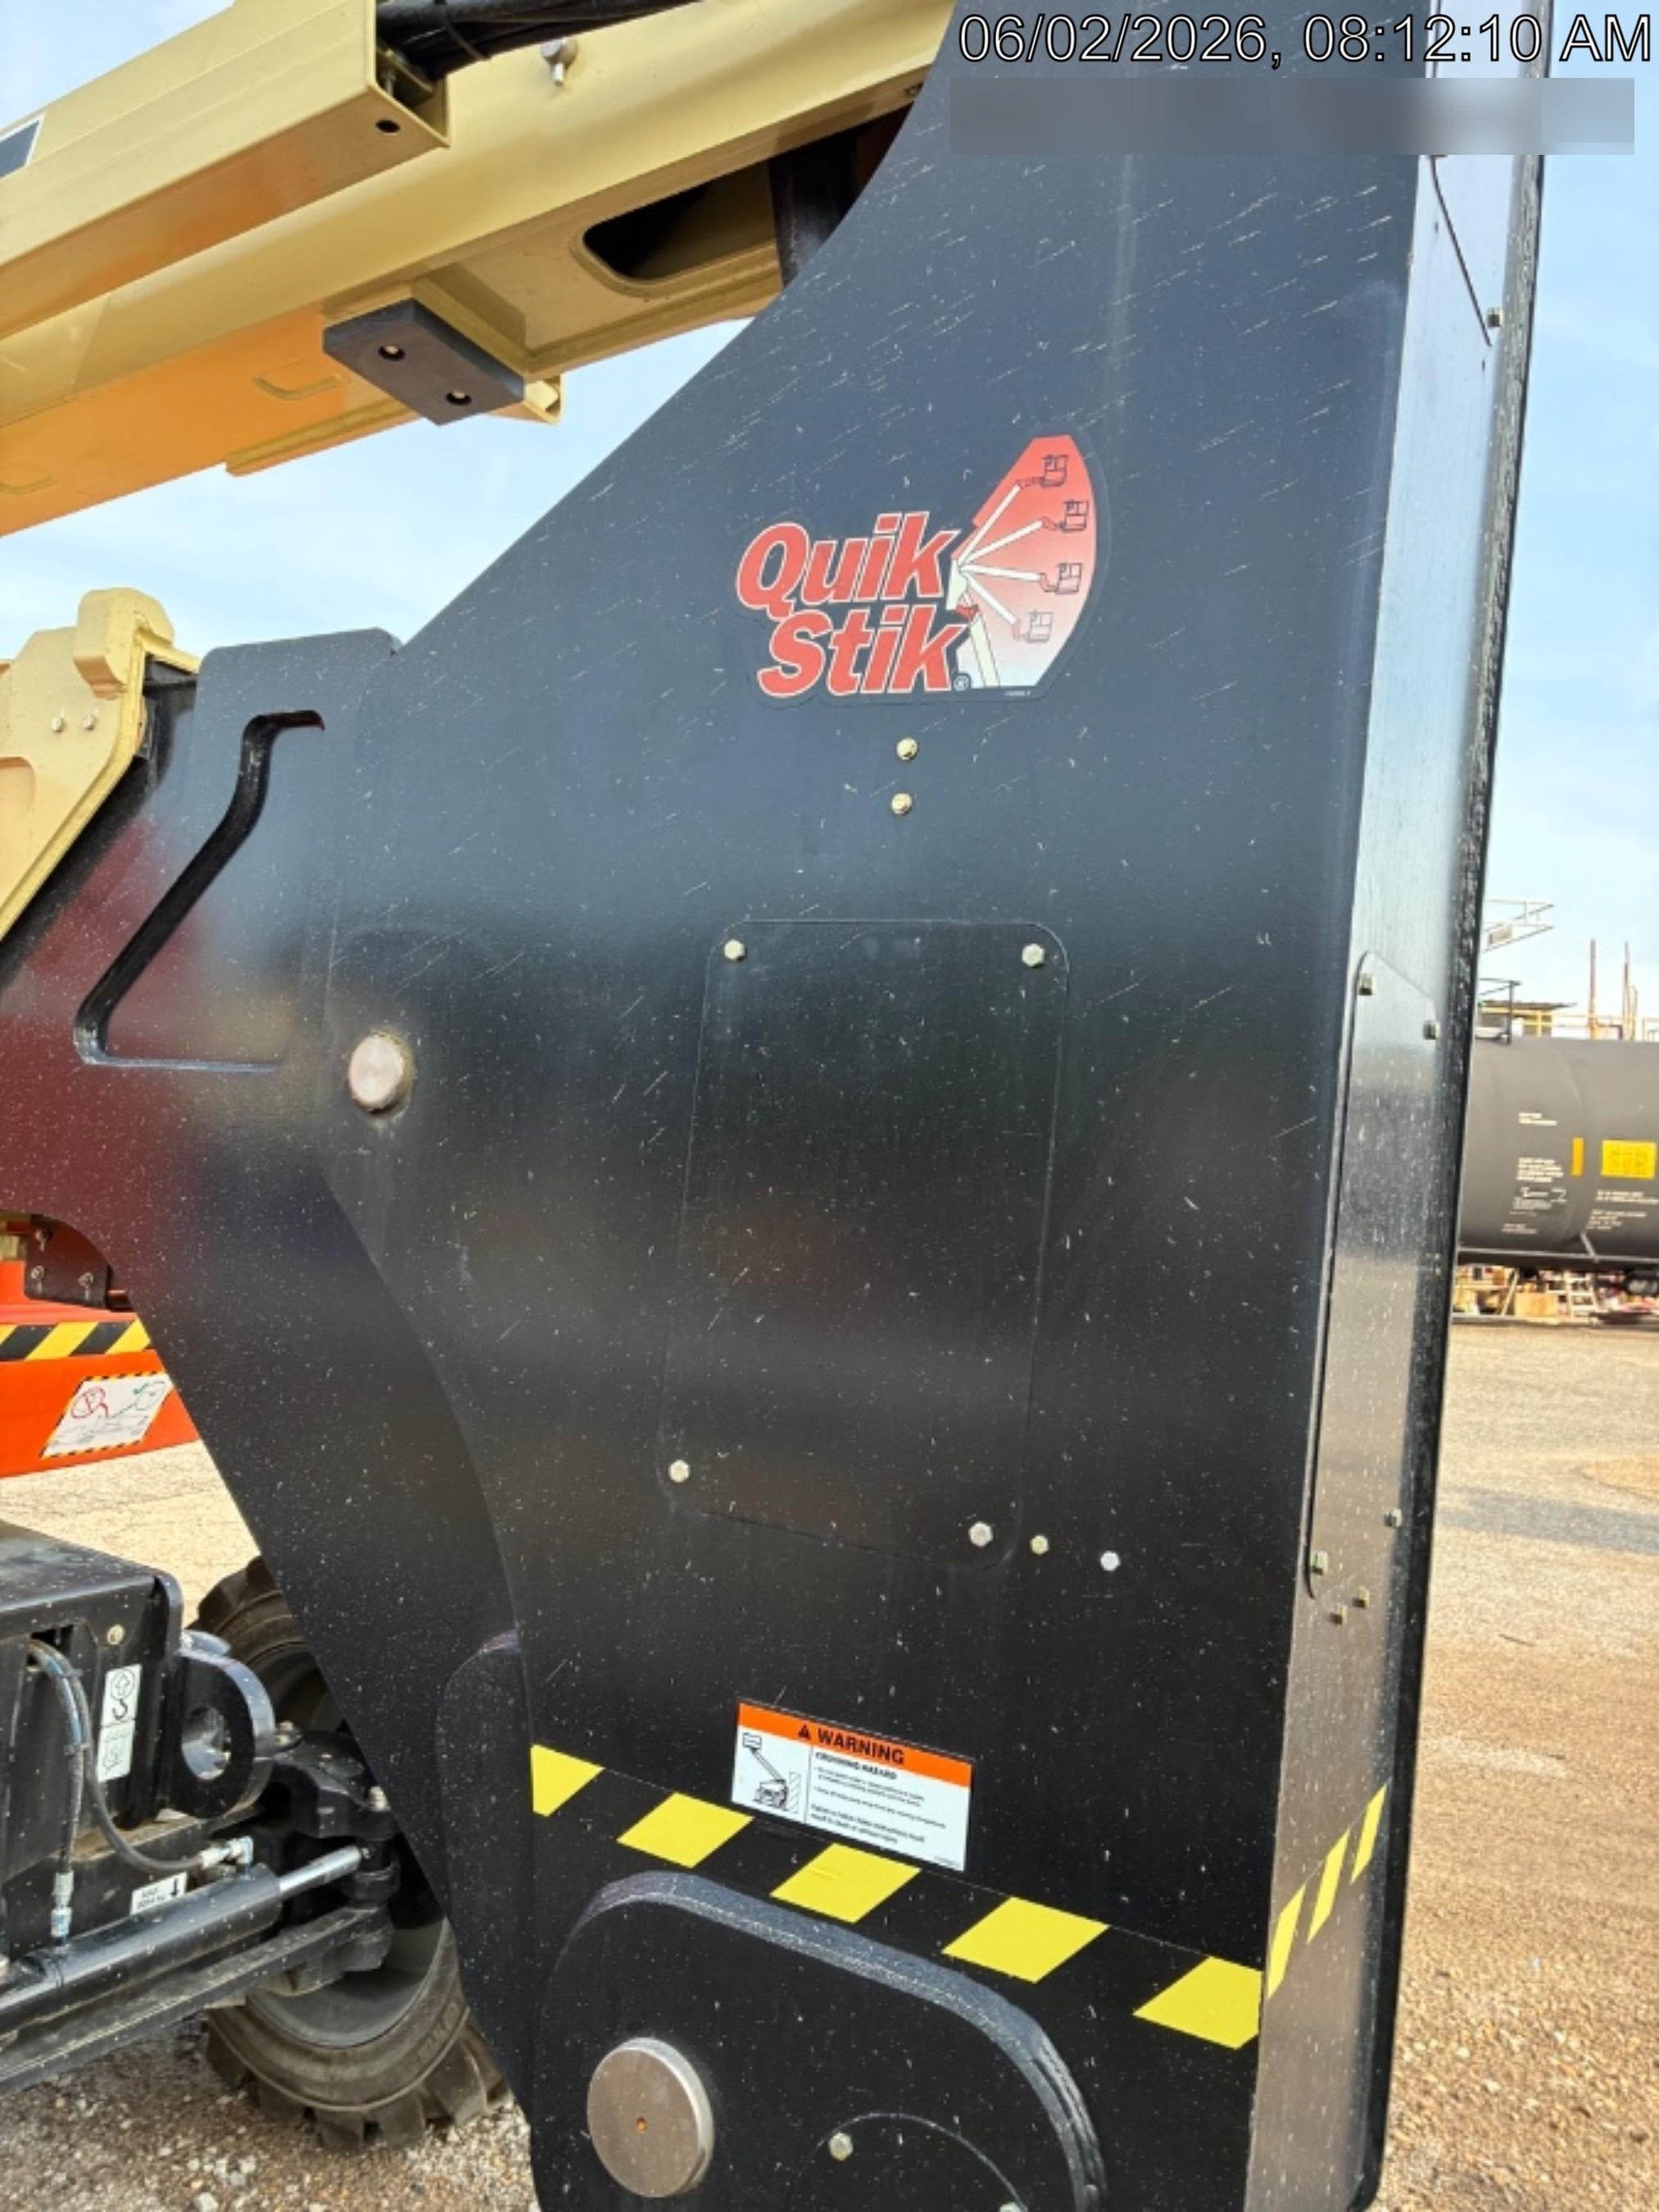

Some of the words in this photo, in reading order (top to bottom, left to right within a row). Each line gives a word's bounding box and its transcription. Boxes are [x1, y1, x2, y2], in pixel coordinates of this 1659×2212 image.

[735, 511, 961, 622] Quik
[756, 601, 970, 699] Stik
[818, 1727, 904, 1765] WARNING
